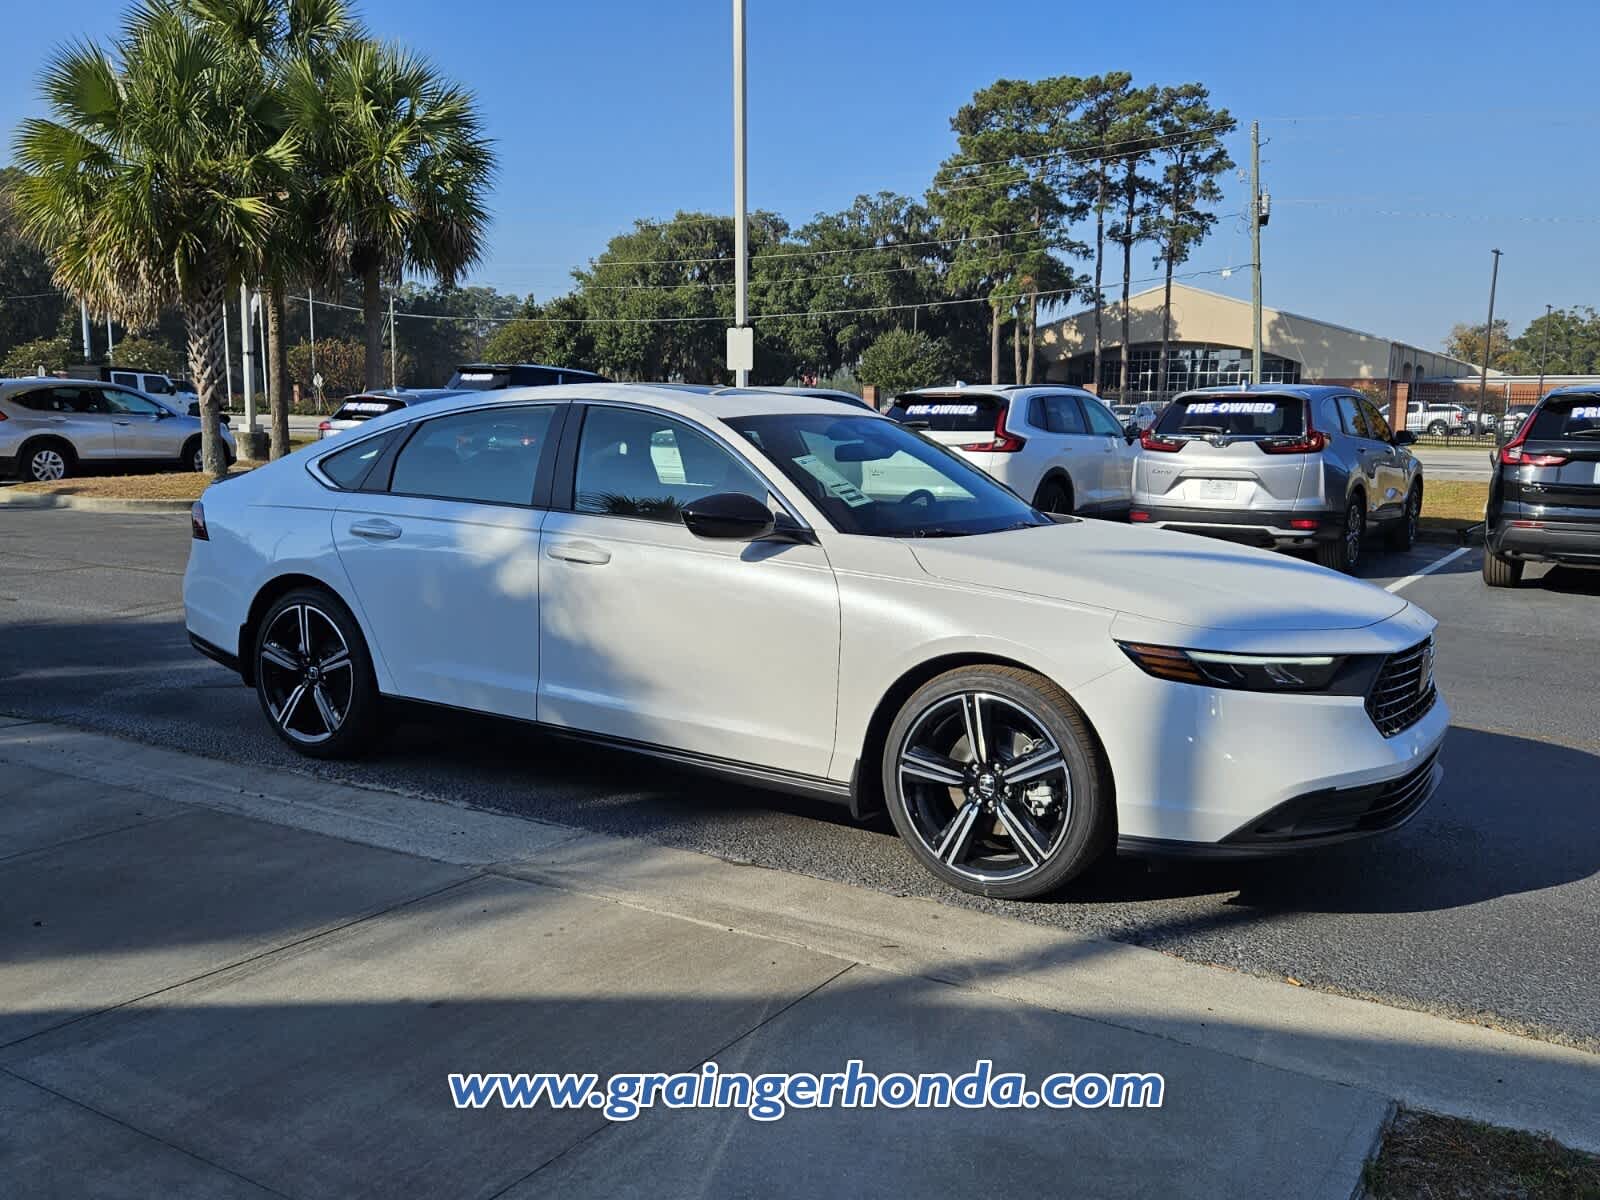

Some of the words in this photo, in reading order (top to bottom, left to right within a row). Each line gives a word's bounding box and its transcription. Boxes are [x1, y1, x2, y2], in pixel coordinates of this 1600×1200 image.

[905, 404, 978, 416] PRE-OWNED
[1185, 402, 1276, 415] PRE-OWNED
[1571, 406, 1600, 418] PR
